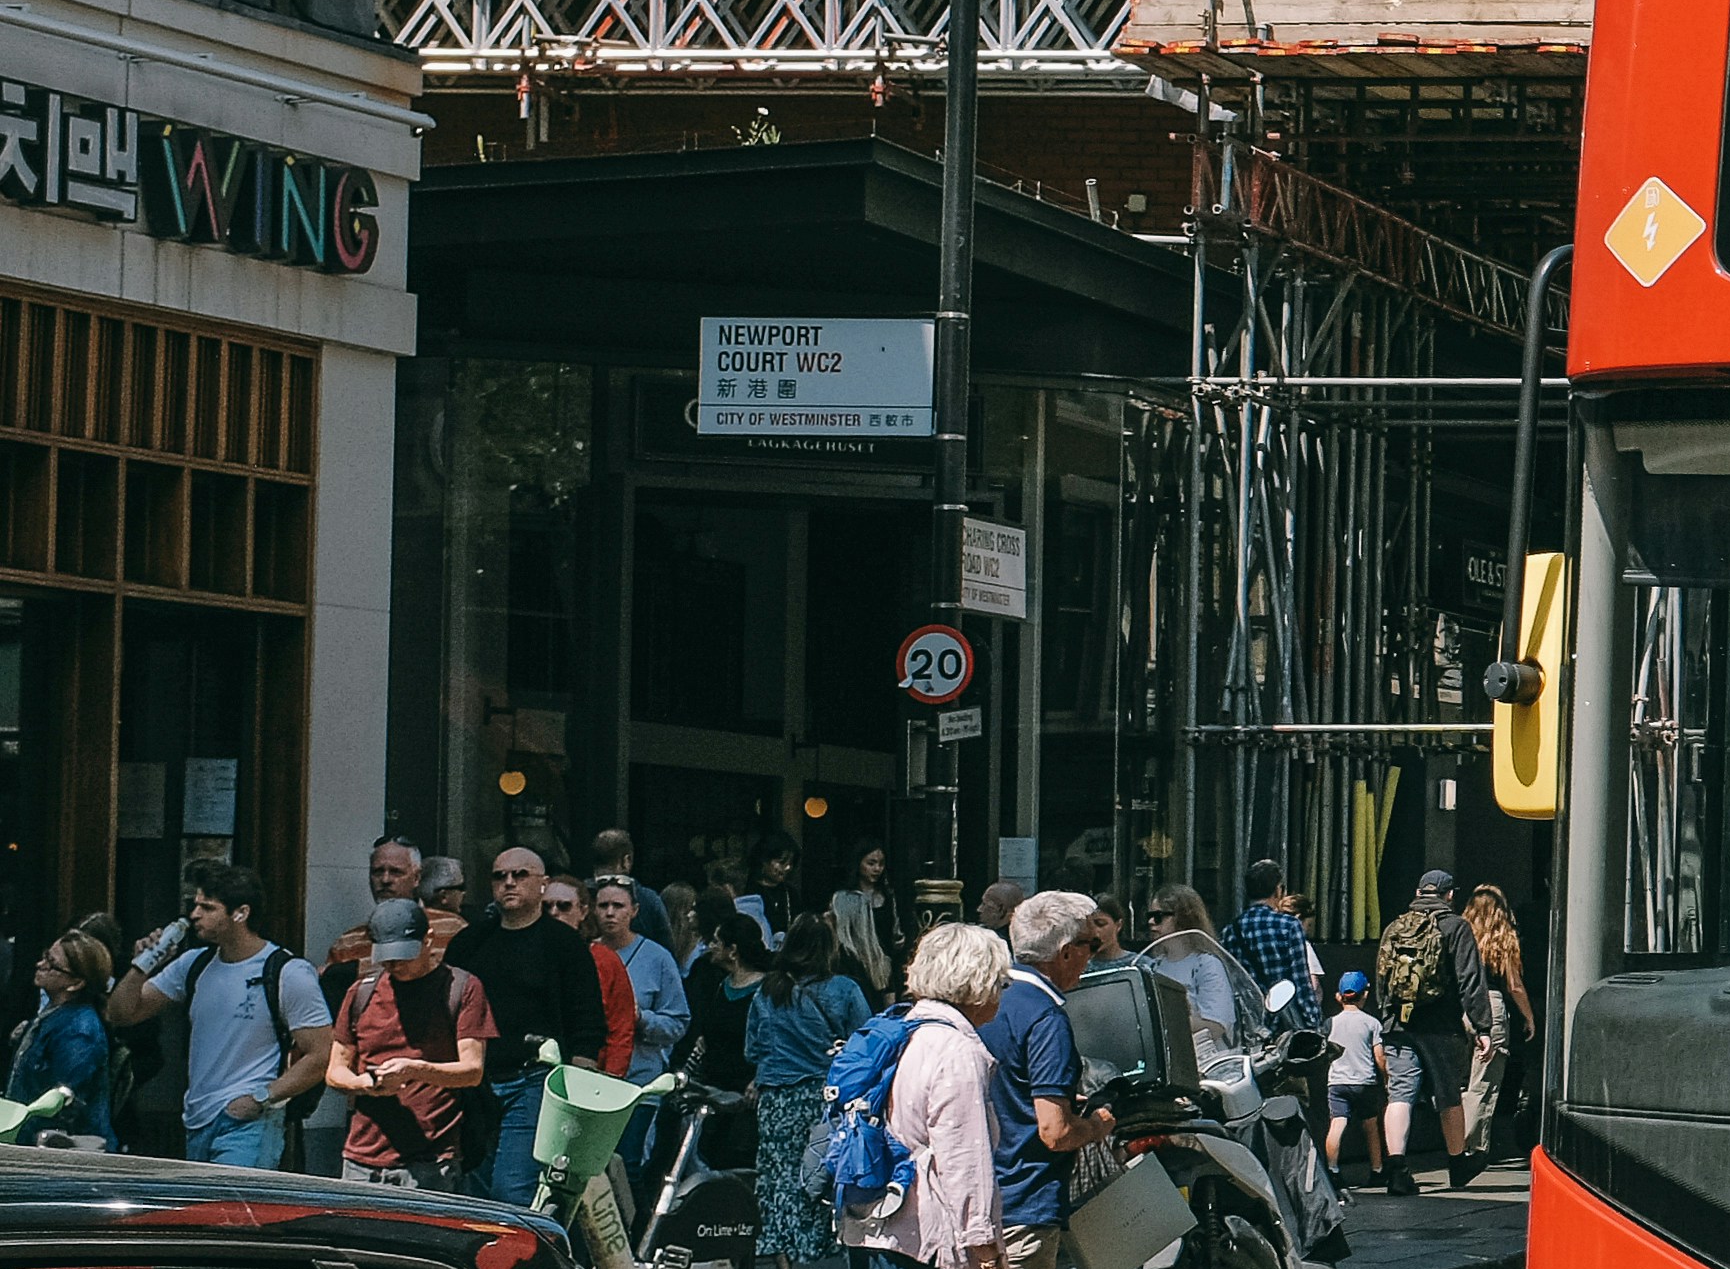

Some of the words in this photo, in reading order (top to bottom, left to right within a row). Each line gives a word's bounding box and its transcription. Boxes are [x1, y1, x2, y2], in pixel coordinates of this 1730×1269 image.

[161, 124, 380, 275] WING
[718, 325, 822, 346] NEWPORT
[717, 351, 788, 372] COURT
[796, 352, 842, 373] WC2
[717, 412, 745, 426] CITY
[749, 413, 765, 426] OF
[769, 413, 861, 427] WESTMINSTER
[910, 648, 962, 681] 20
[697, 1224, 712, 1237] On
[713, 1224, 732, 1237] Lime
